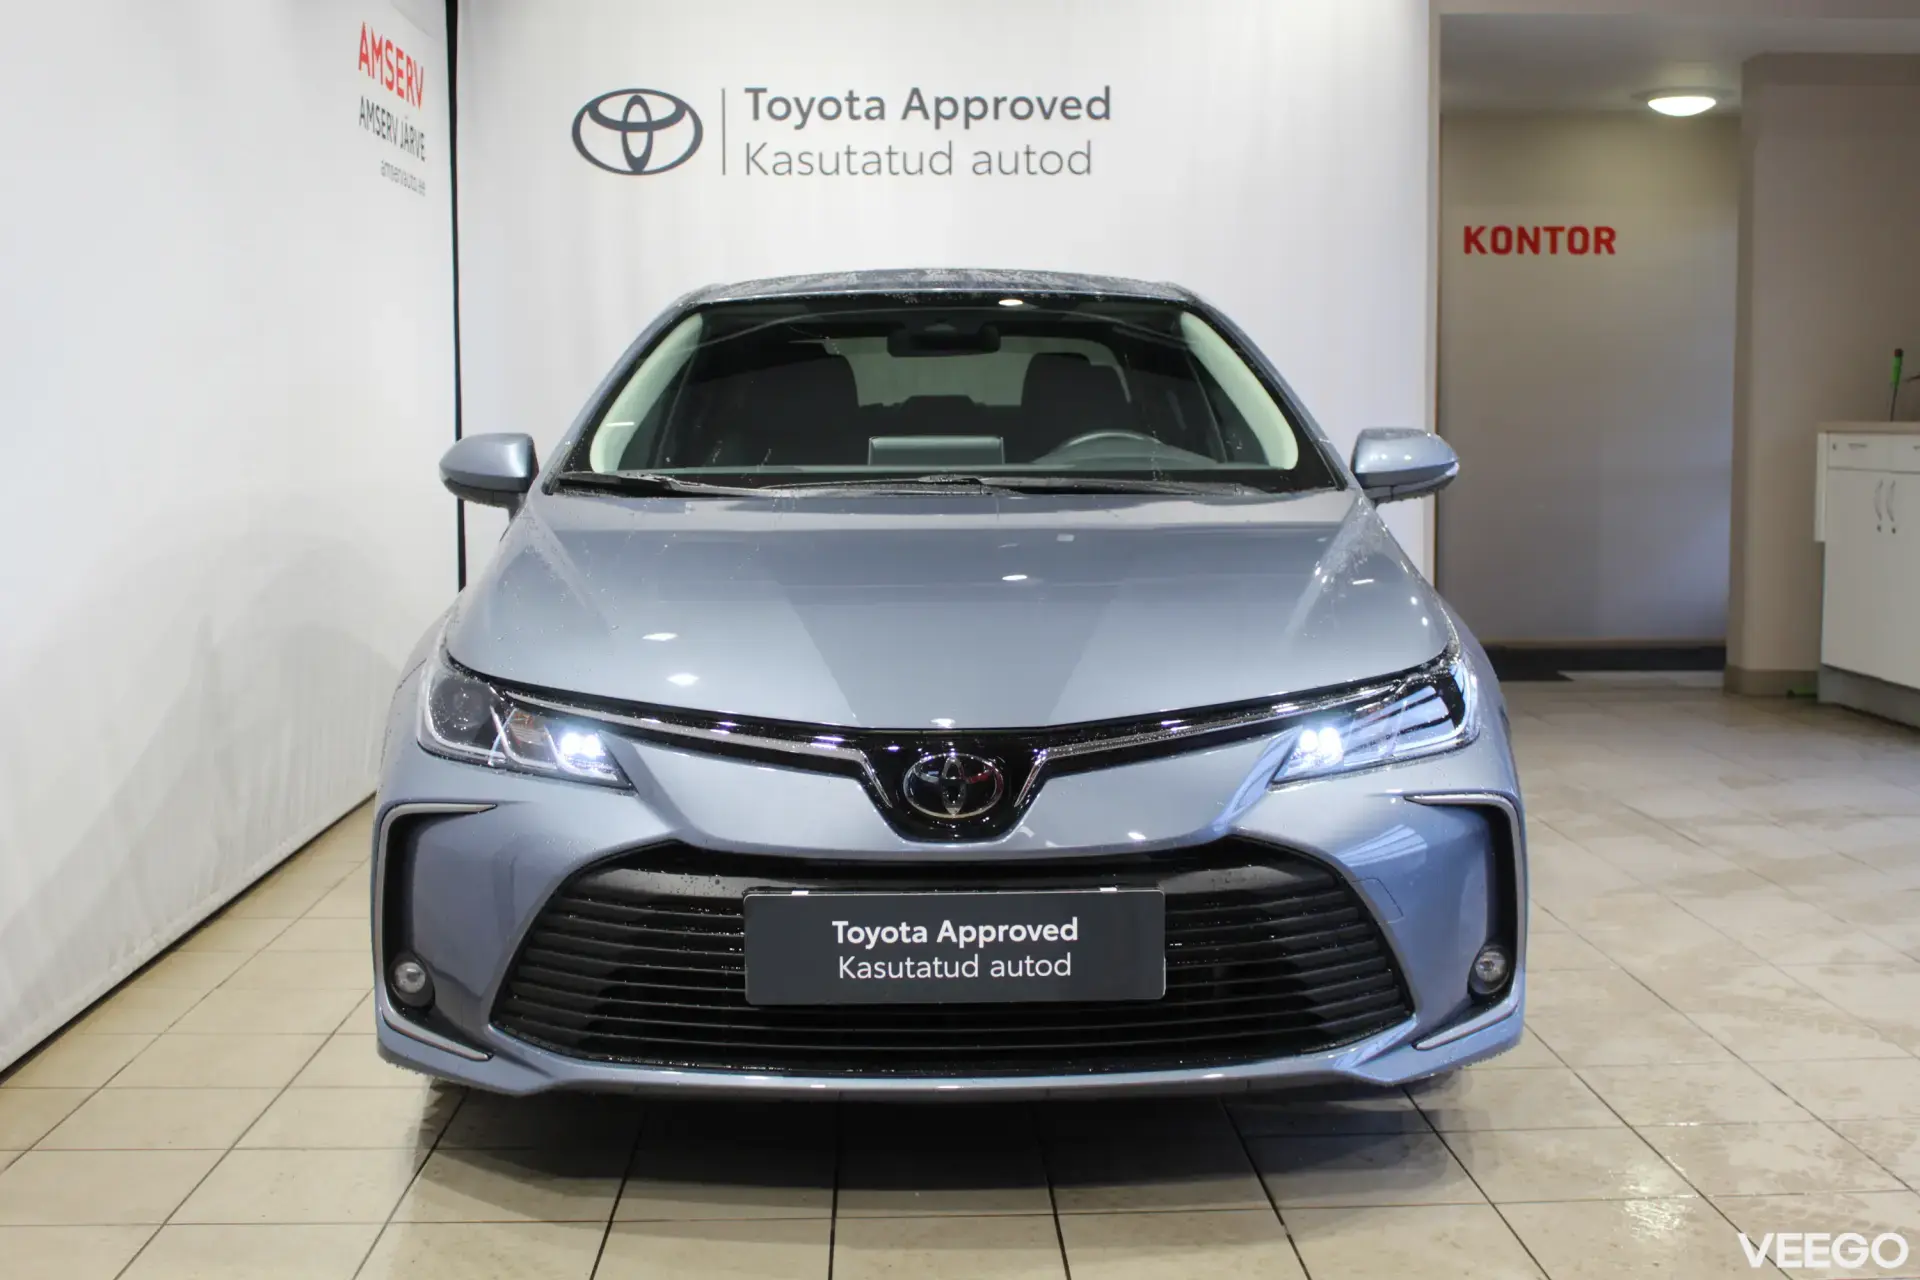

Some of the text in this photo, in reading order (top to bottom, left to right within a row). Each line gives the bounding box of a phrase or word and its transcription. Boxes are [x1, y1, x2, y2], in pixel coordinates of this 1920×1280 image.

[358, 21, 424, 110] AMSERV
[359, 95, 398, 146] AMSERV
[744, 85, 1112, 130] Toyota Approved
[745, 140, 1091, 176] Kasutatud autod
[1463, 225, 1616, 255] KONTOR
[831, 916, 1079, 950] Toyota Approved
[839, 952, 1072, 979] Kasutatud autod
